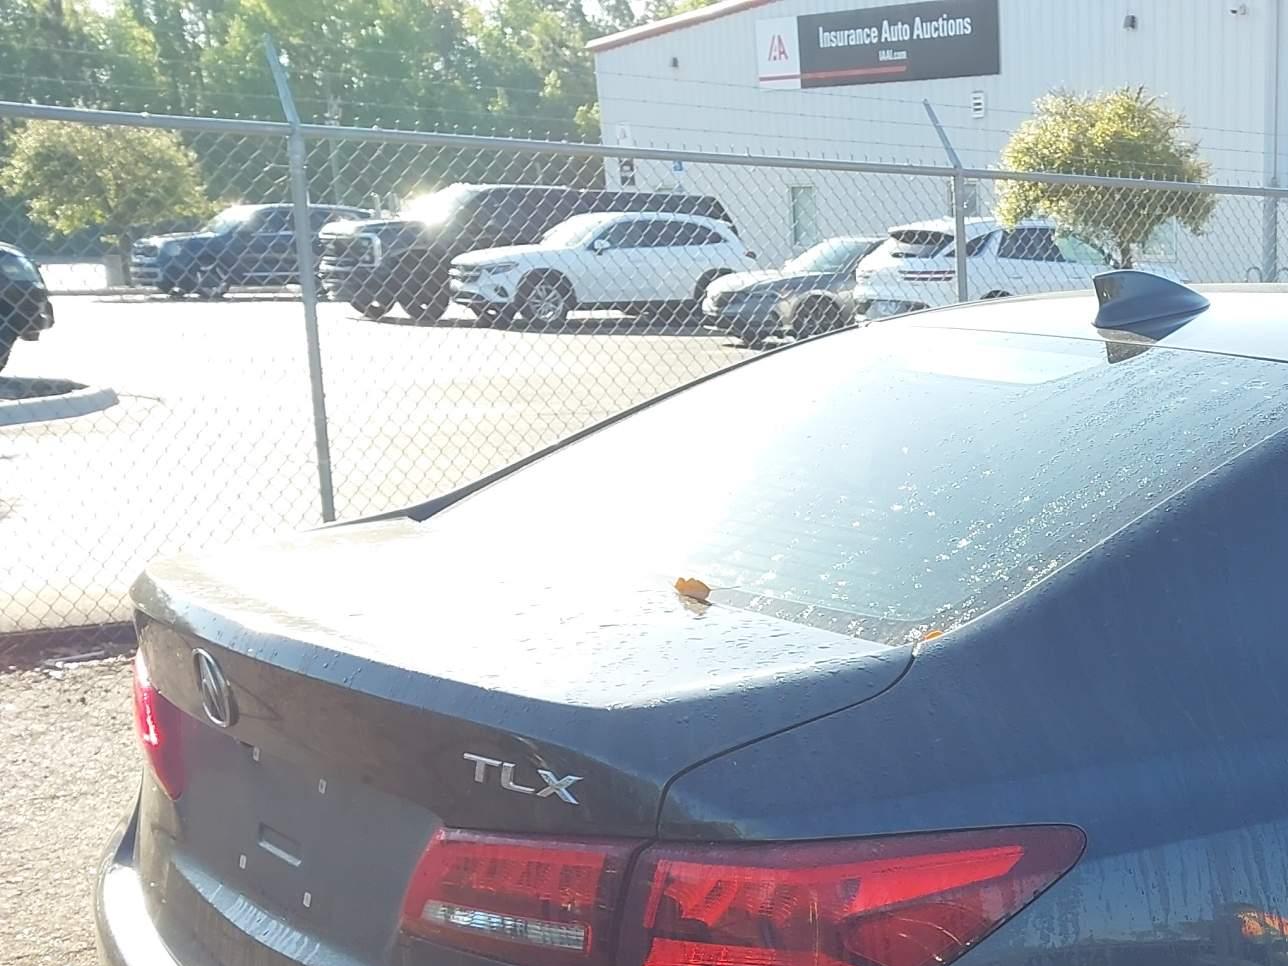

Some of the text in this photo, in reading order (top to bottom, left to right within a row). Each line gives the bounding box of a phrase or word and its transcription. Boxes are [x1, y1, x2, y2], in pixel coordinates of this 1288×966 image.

[818, 13, 972, 48] Insurance Auto Auctions
[463, 752, 584, 805] TLX
